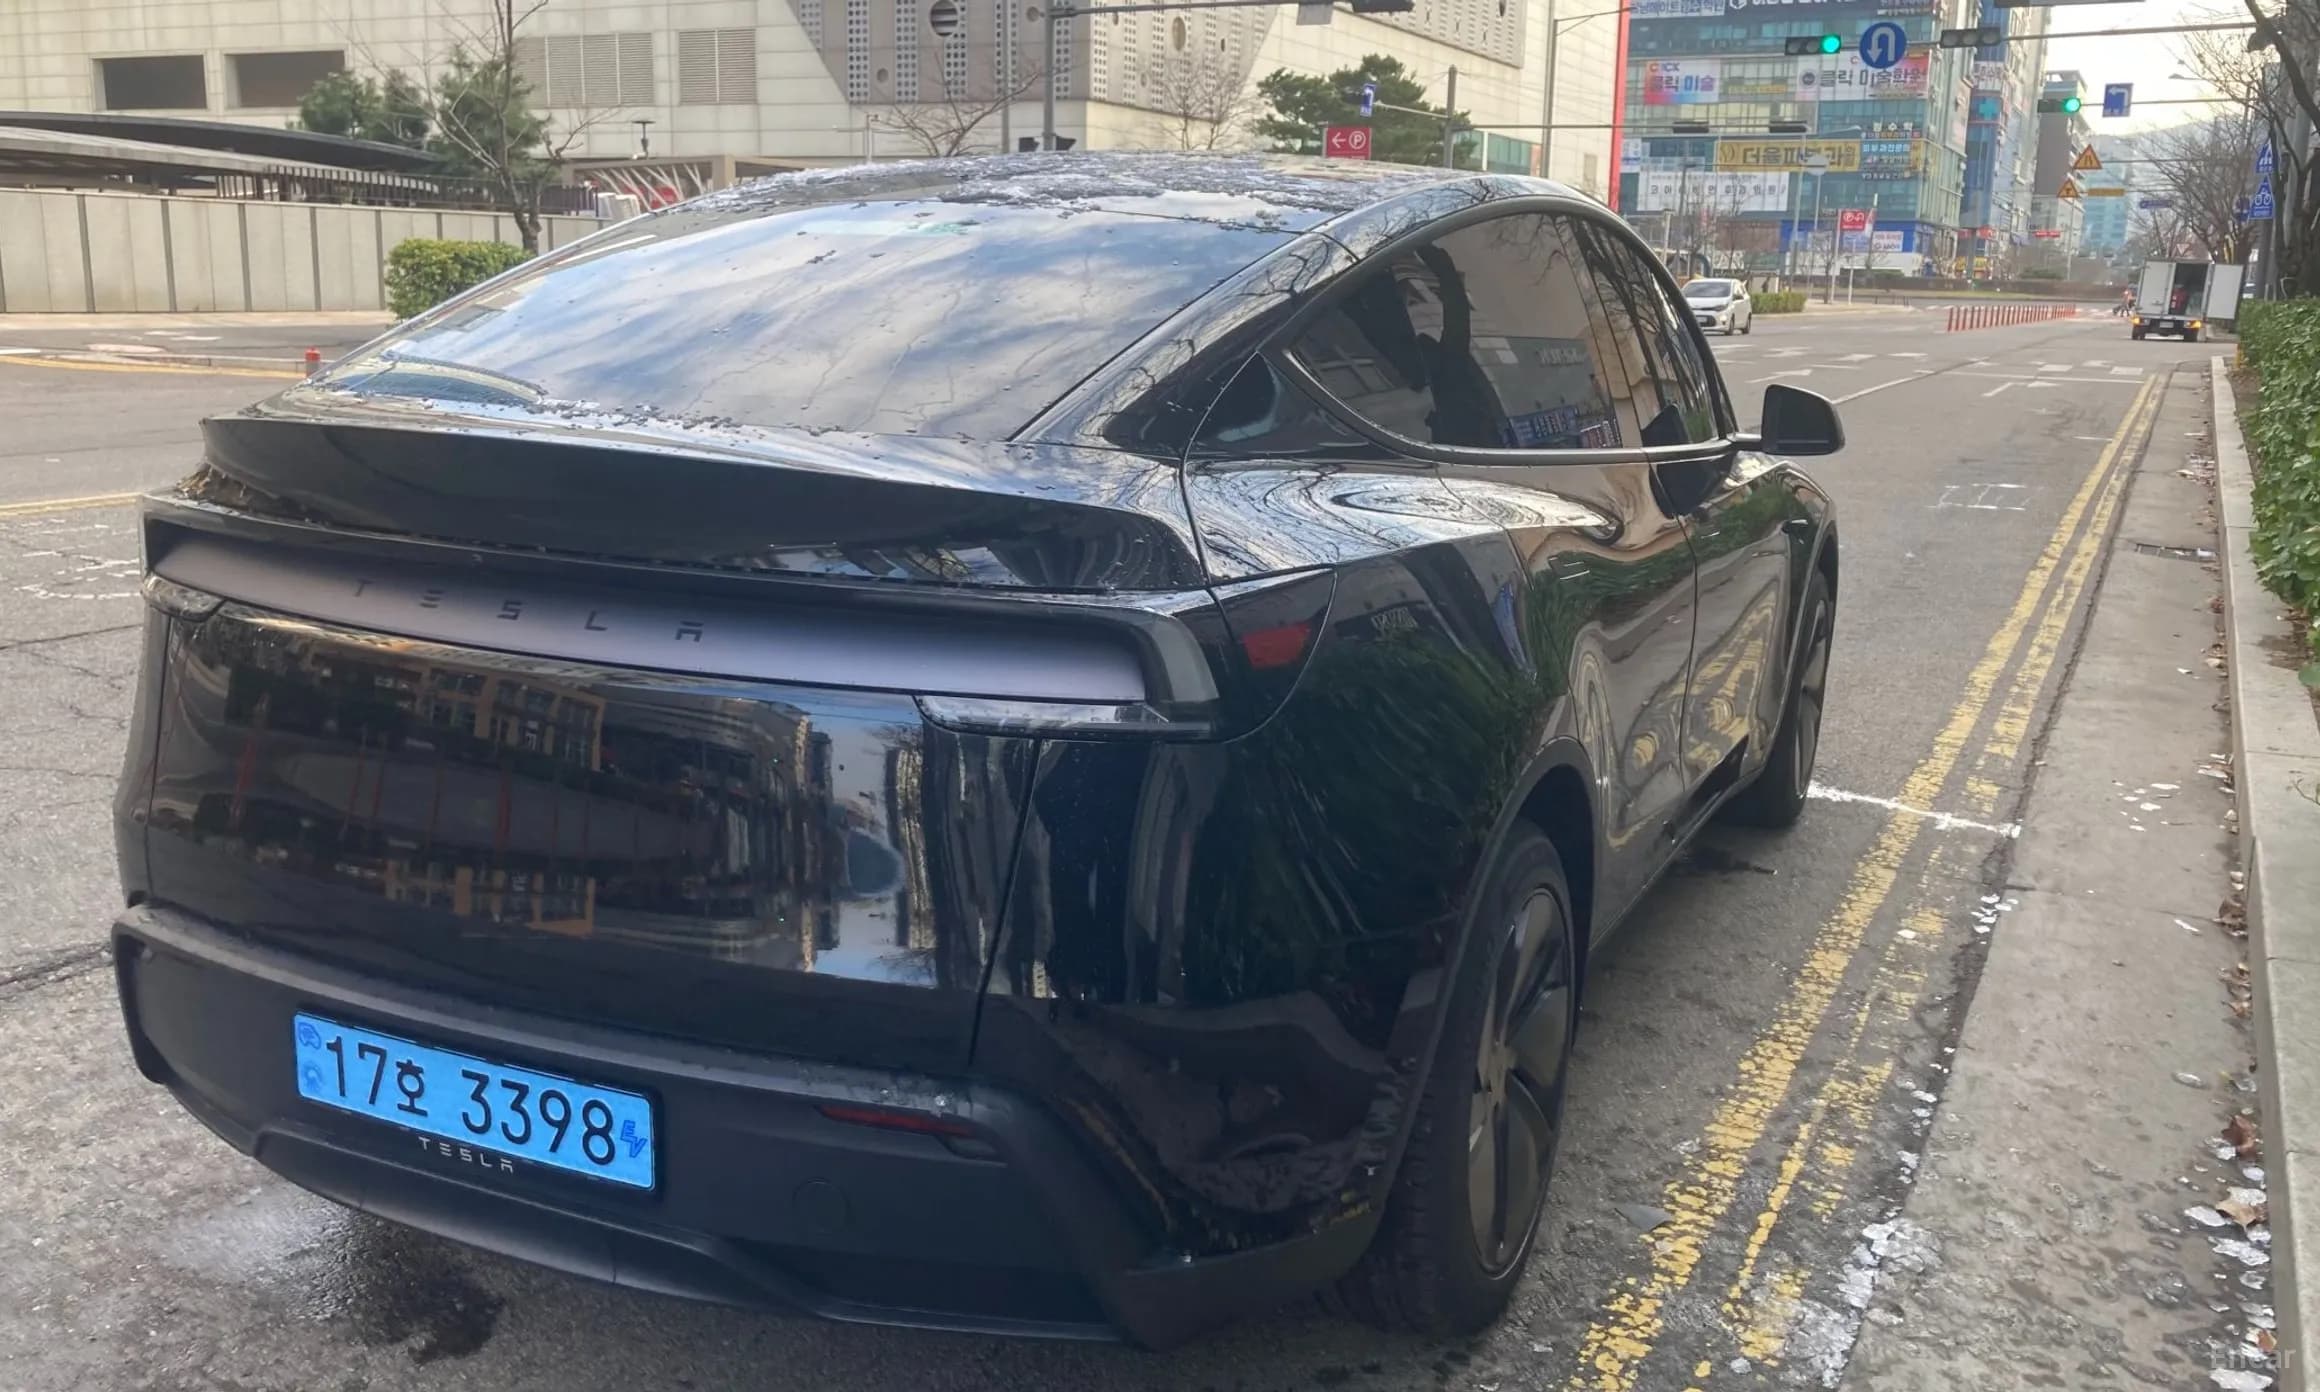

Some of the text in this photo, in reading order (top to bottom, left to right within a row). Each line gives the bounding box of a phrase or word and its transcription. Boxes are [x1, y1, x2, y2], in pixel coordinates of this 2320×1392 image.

[1820, 69, 1853, 87] 클릭
[352, 578, 704, 643] TESLA
[326, 1035, 616, 1167] 17호 3398
[418, 1135, 514, 1173] TESLA
[620, 1119, 648, 1159] EV
